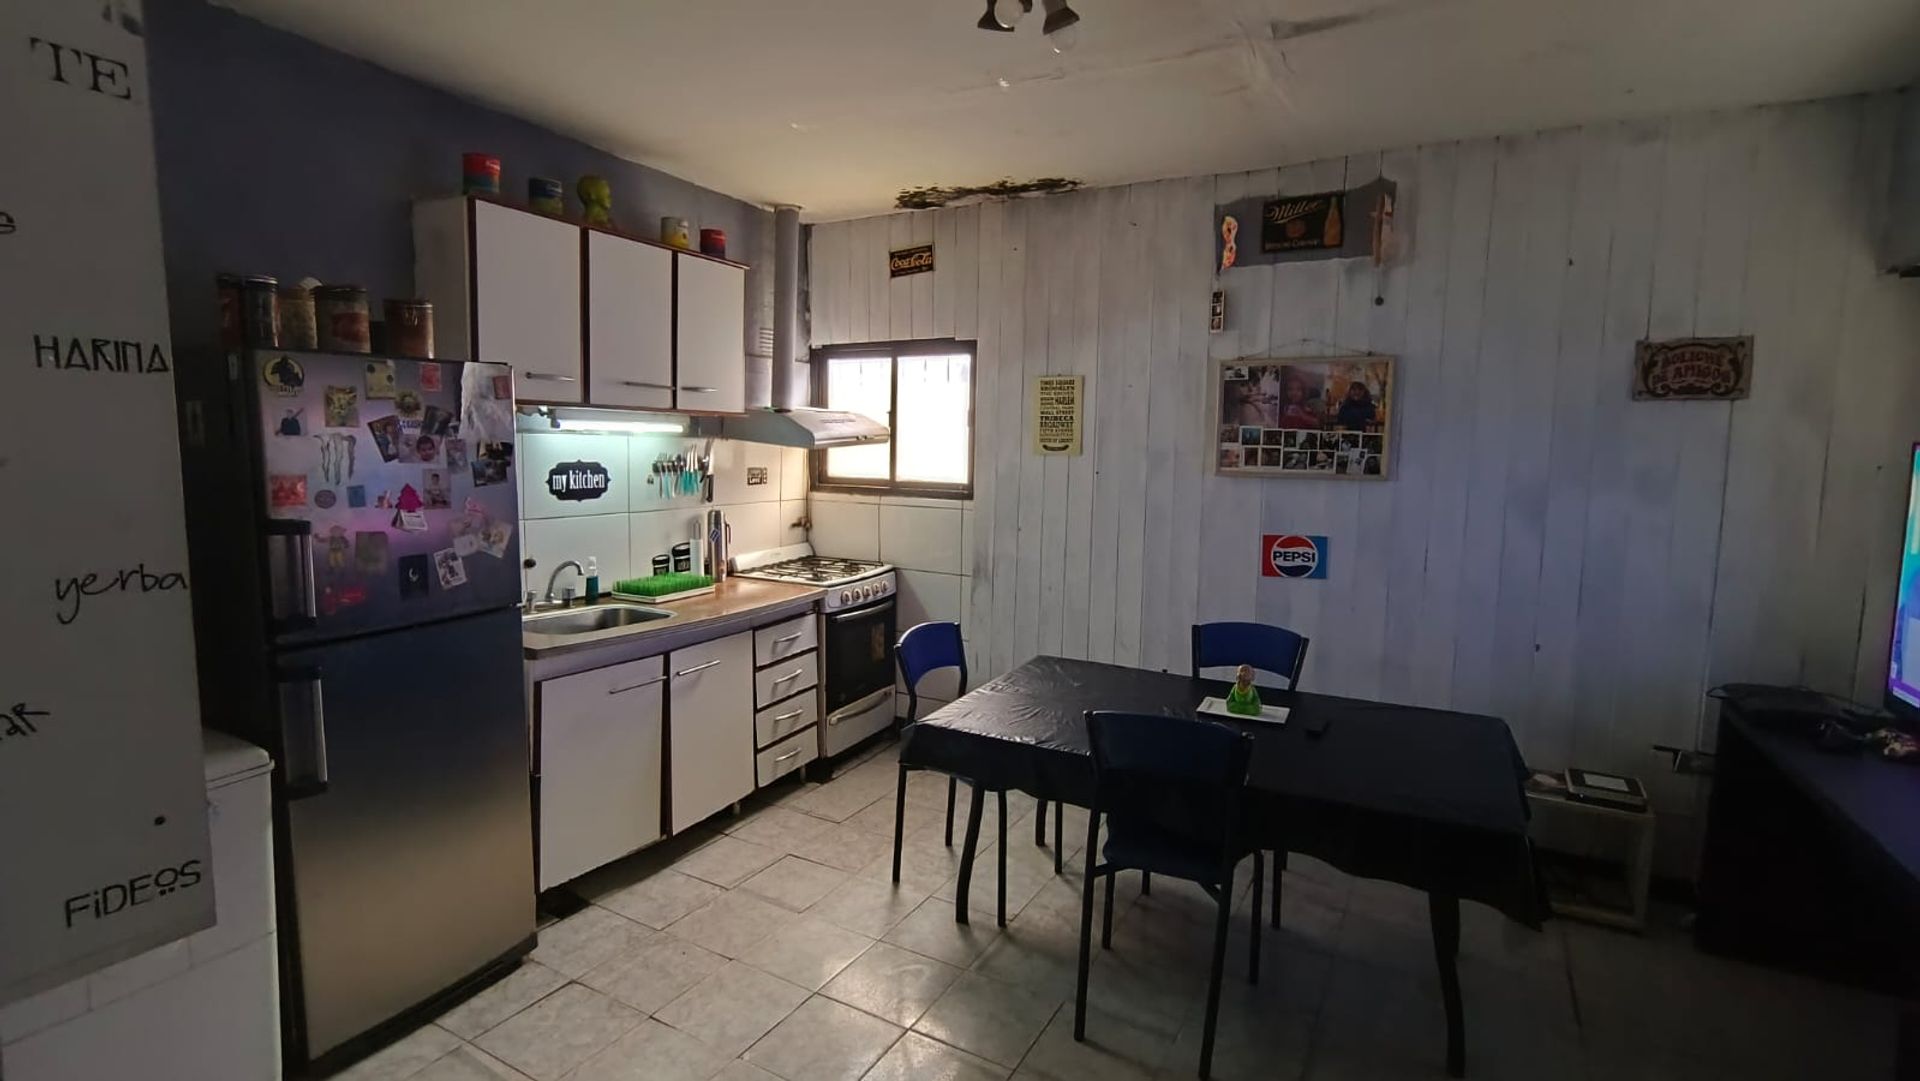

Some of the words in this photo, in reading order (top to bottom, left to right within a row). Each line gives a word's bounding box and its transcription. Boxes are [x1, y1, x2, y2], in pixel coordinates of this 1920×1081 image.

[29, 37, 131, 100] TE
[552, 473, 567, 493] my
[569, 470, 605, 490] kitchen
[1273, 551, 1315, 563] PEPSI
[55, 563, 188, 624] yerba
